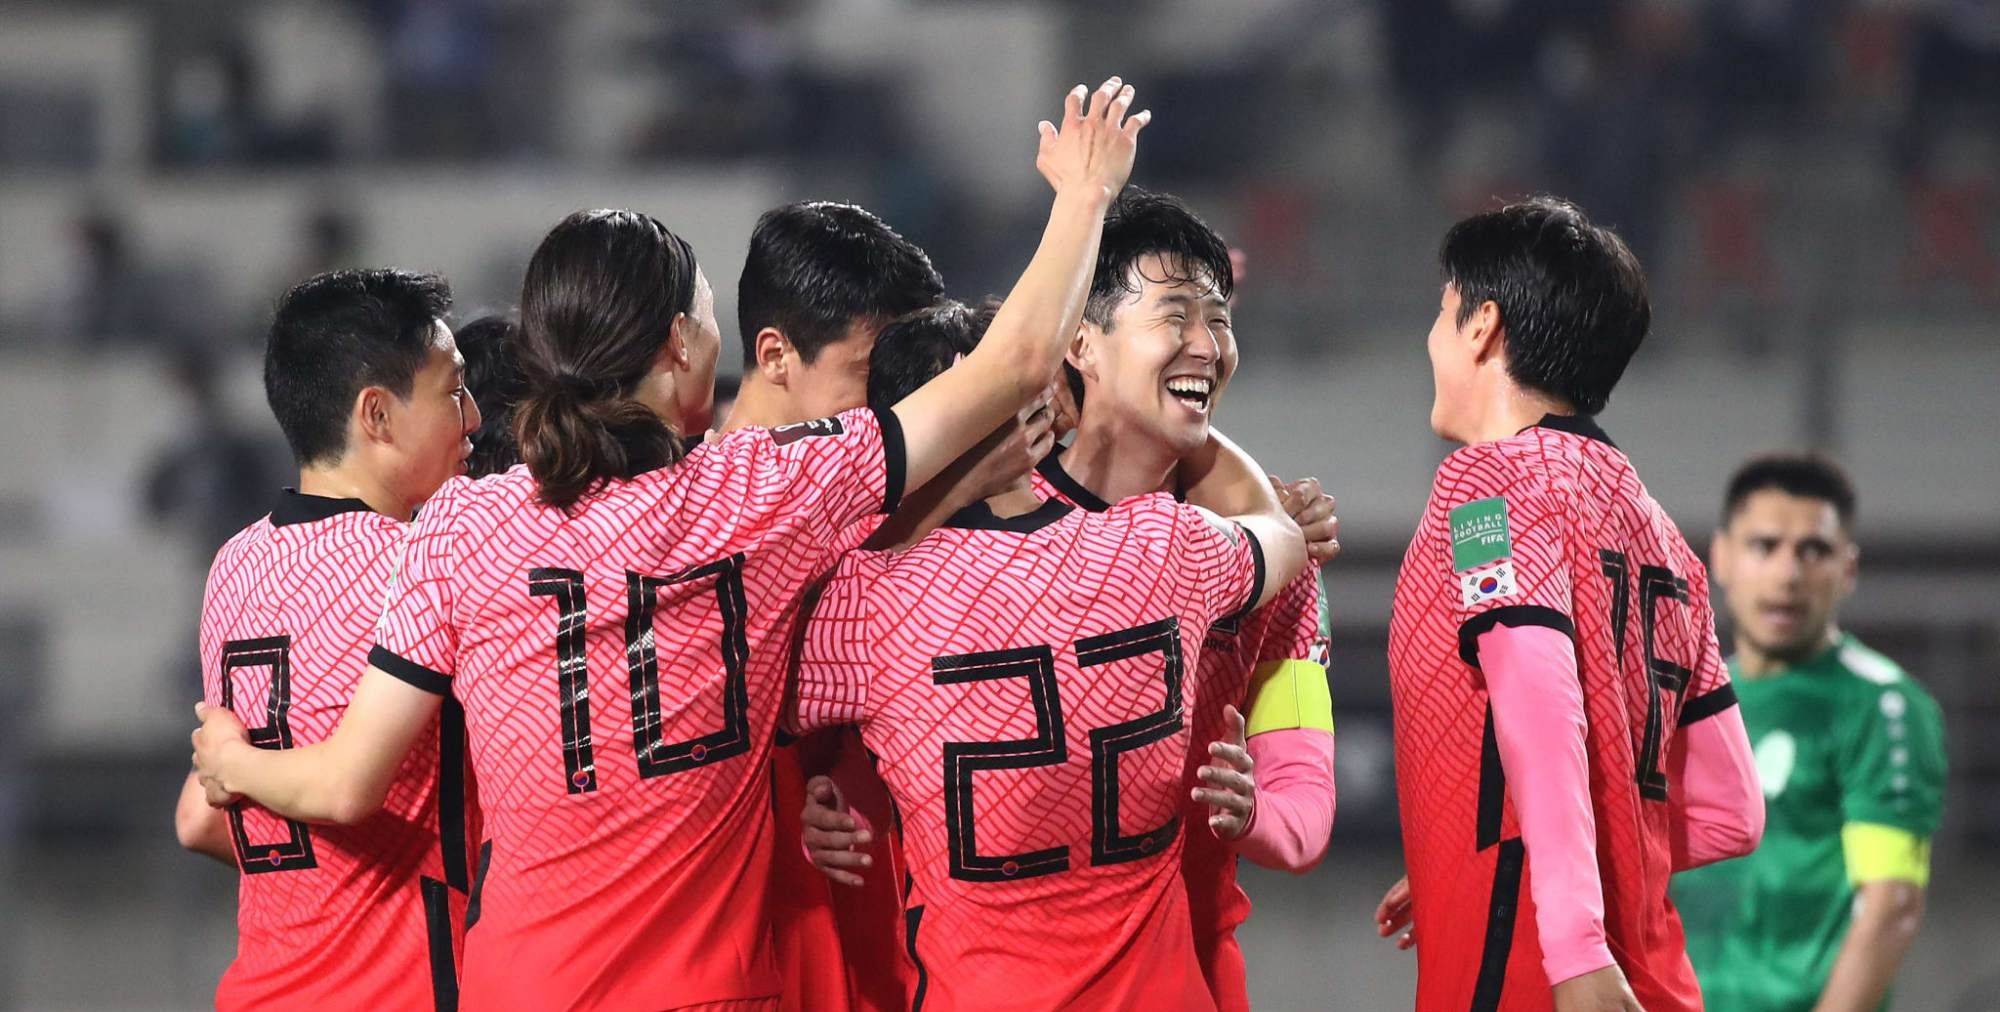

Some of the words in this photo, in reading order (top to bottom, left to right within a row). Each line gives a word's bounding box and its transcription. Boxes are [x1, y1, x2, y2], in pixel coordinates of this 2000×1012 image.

[1454, 513, 1502, 532] LIVING
[1454, 520, 1503, 540] FOOTBALL
[1481, 533, 1504, 545] FIFA
[529, 552, 750, 795] 10
[221, 634, 318, 875] 8
[931, 615, 1184, 883] 22
